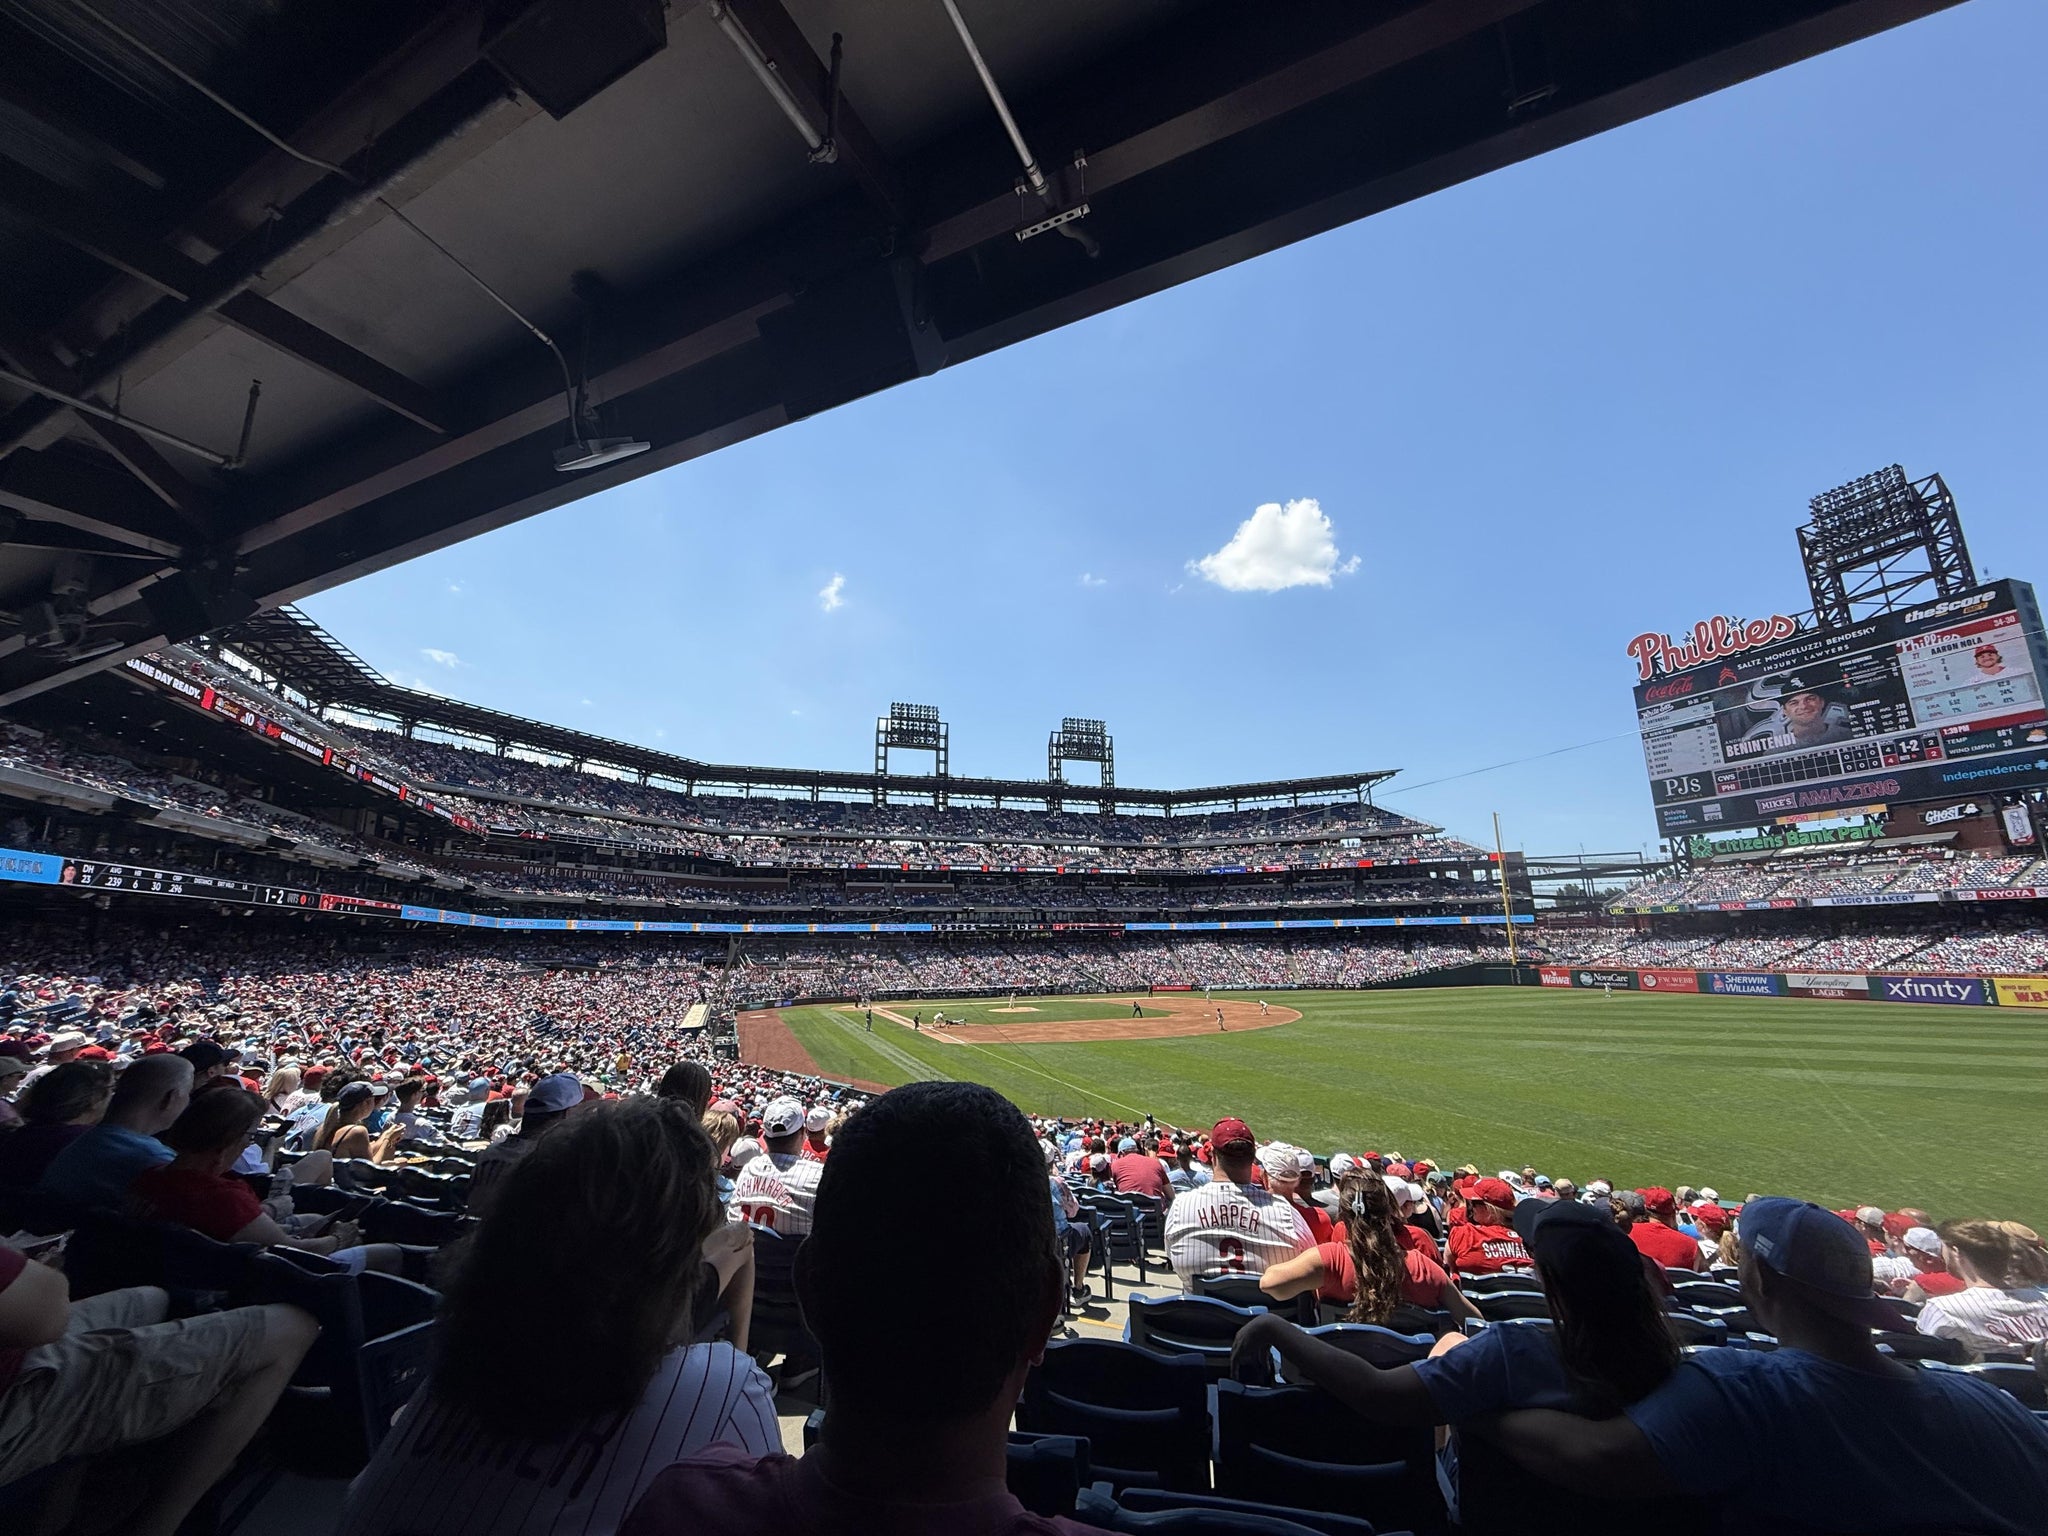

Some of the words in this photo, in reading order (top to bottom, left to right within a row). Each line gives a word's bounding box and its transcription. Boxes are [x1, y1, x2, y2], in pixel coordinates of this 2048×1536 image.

[1905, 590, 1996, 623] theScore
[1627, 614, 1795, 680] Phillies
[1737, 659, 1762, 671] SALTZ
[1764, 643, 1822, 662] MONGELUZZI
[1825, 625, 1877, 645] BENDESKY
[1897, 632, 1961, 654] Phillies
[1931, 643, 1959, 655] AARON
[1960, 636, 1983, 648] NOLA
[1763, 658, 1797, 672] INJURY
[1804, 644, 1850, 661] LAWYERS
[154, 669, 173, 686] DAY
[1726, 733, 1797, 758] BENINTENDI
[1946, 737, 1968, 745] TEMP
[1717, 773, 1736, 783] CWS
[1899, 740, 1920, 754] 1-2
[1942, 762, 2032, 782] Independence
[1721, 784, 1736, 793] PHI
[1798, 778, 1900, 807] AMAZING
[1761, 797, 1792, 810] MIKE'S
[1925, 803, 1966, 826] GHOST
[1715, 833, 1784, 854] Citizens
[1786, 827, 1836, 846] Bank
[1838, 820, 1886, 841] Park
[83, 864, 95, 874] DH
[109, 867, 122, 875] AVG
[81, 875, 91, 884] 23
[104, 877, 123, 888] .239
[133, 880, 139, 889] 6
[151, 882, 161, 891] 30
[168, 883, 183, 894] .296
[265, 888, 284, 904] 1-2
[1831, 896, 1872, 905] LISCIO'S
[1874, 894, 1916, 903] BAKERY
[1980, 889, 2031, 899] TOYOTA
[1609, 907, 1625, 915] UKG
[1635, 906, 1651, 914] UKG
[1662, 905, 1679, 913] UKG
[1721, 902, 1745, 910] NECA
[1771, 900, 1796, 908] NECA
[1541, 973, 1570, 985] Wawa
[1593, 973, 1628, 983] NovaCare
[1725, 974, 1767, 984] SHERWIN
[1802, 976, 1850, 988] Yuengling
[1811, 989, 1845, 997] LAGER
[1887, 978, 1972, 1000] xfinity
[735, 1175, 795, 1208] SCHWARBER
[1197, 1204, 1260, 1234] HARPER
[1219, 1237, 1246, 1274] 3
